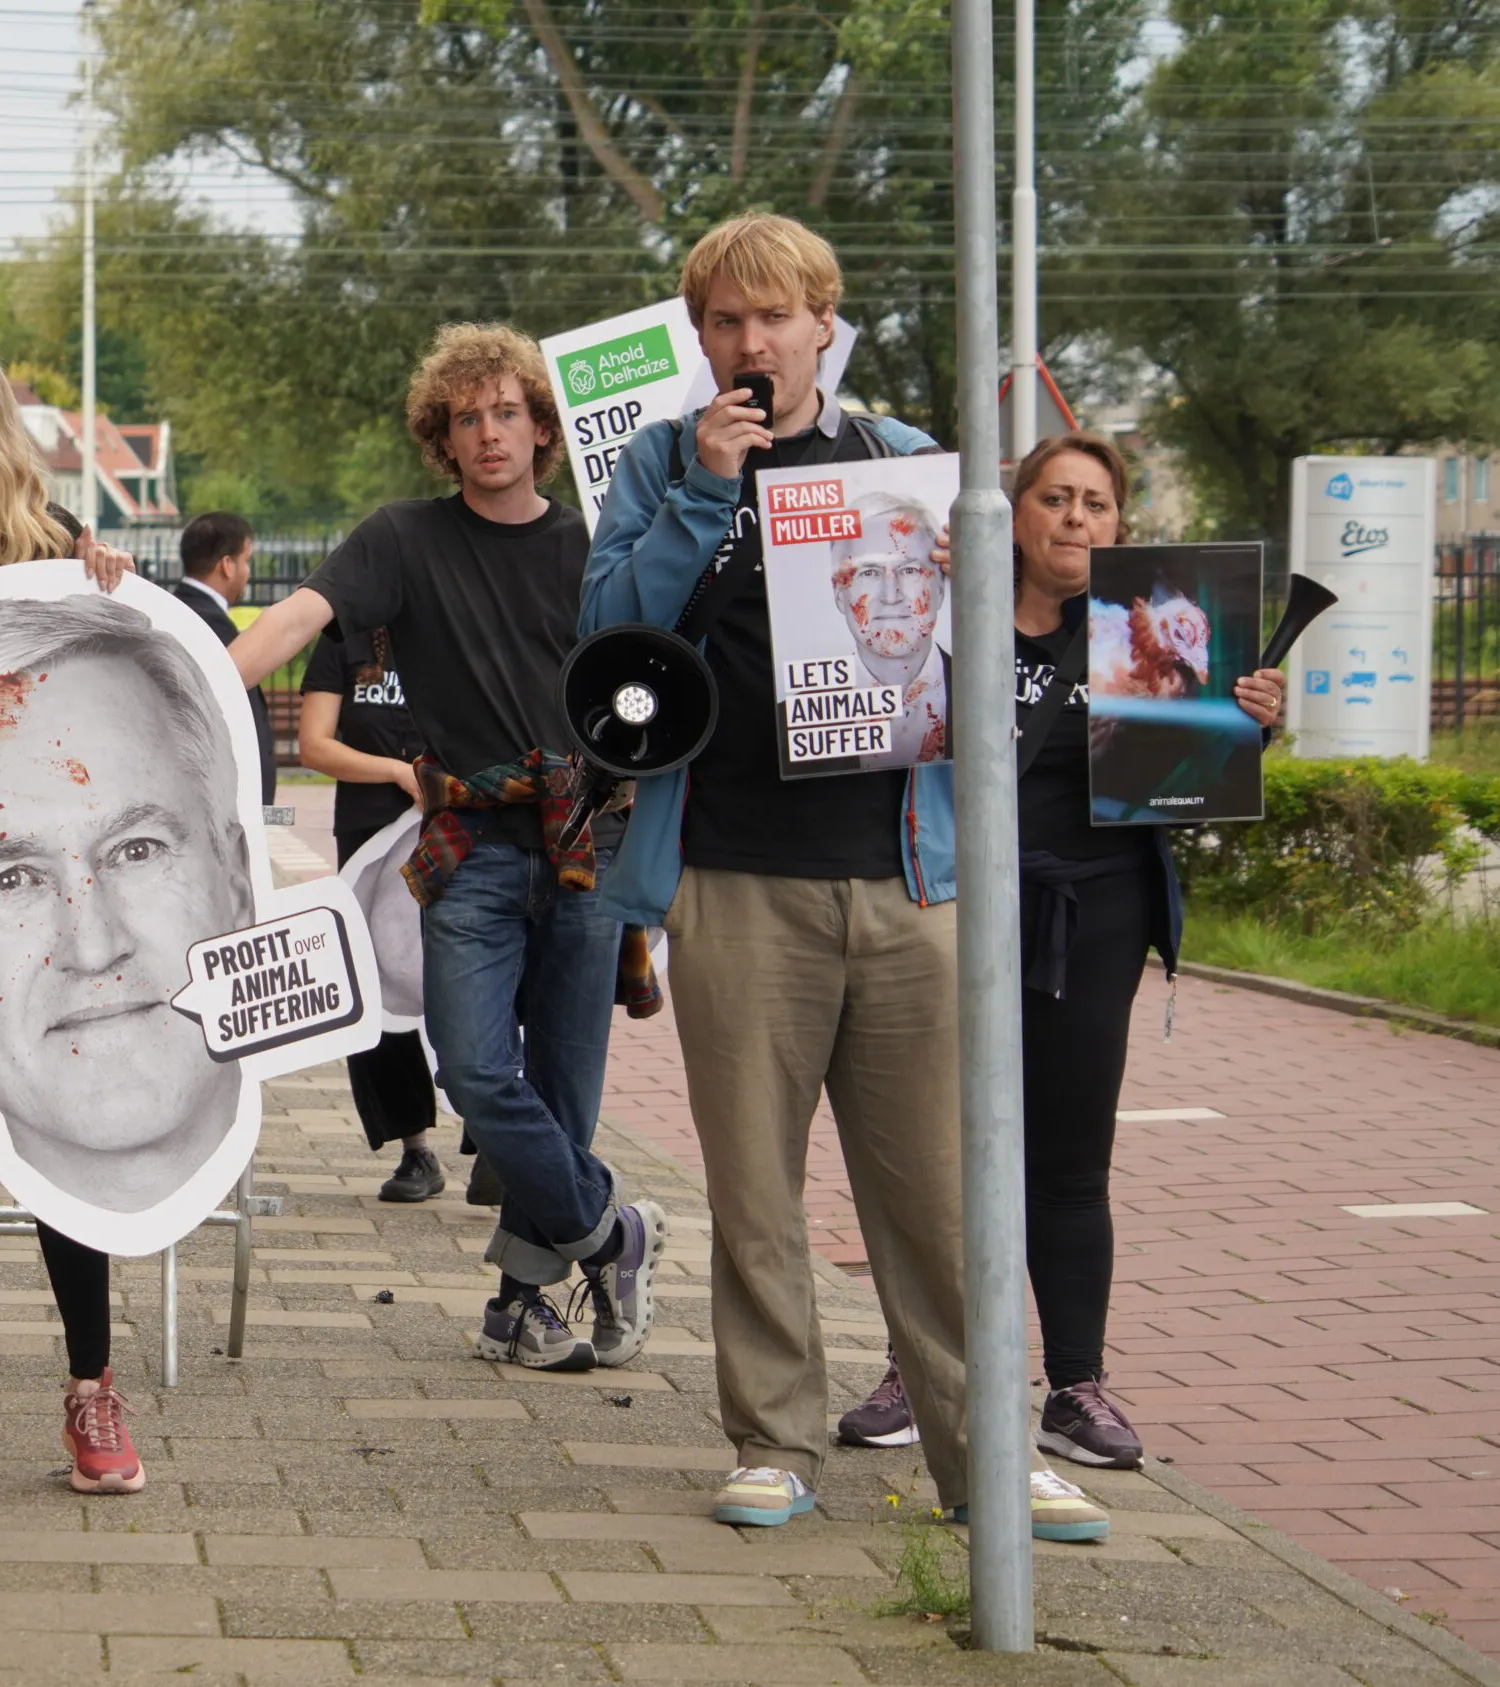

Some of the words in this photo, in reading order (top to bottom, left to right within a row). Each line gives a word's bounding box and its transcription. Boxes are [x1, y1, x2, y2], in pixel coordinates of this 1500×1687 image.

[599, 343, 645, 371] Ahold
[601, 358, 669, 388] Delhaize
[575, 400, 642, 445] STOP
[584, 444, 625, 483] DE
[772, 484, 839, 509] FRANS
[775, 515, 855, 542] MULLER
[1341, 520, 1389, 546] Etos
[789, 659, 849, 688] LETS
[791, 689, 896, 723] ANIMALS
[793, 726, 884, 757] SUFFER
[203, 928, 291, 980] PROFIT
[294, 932, 327, 955] over
[231, 958, 316, 1007] ANIMAL
[218, 982, 340, 1042] SUFFERING
